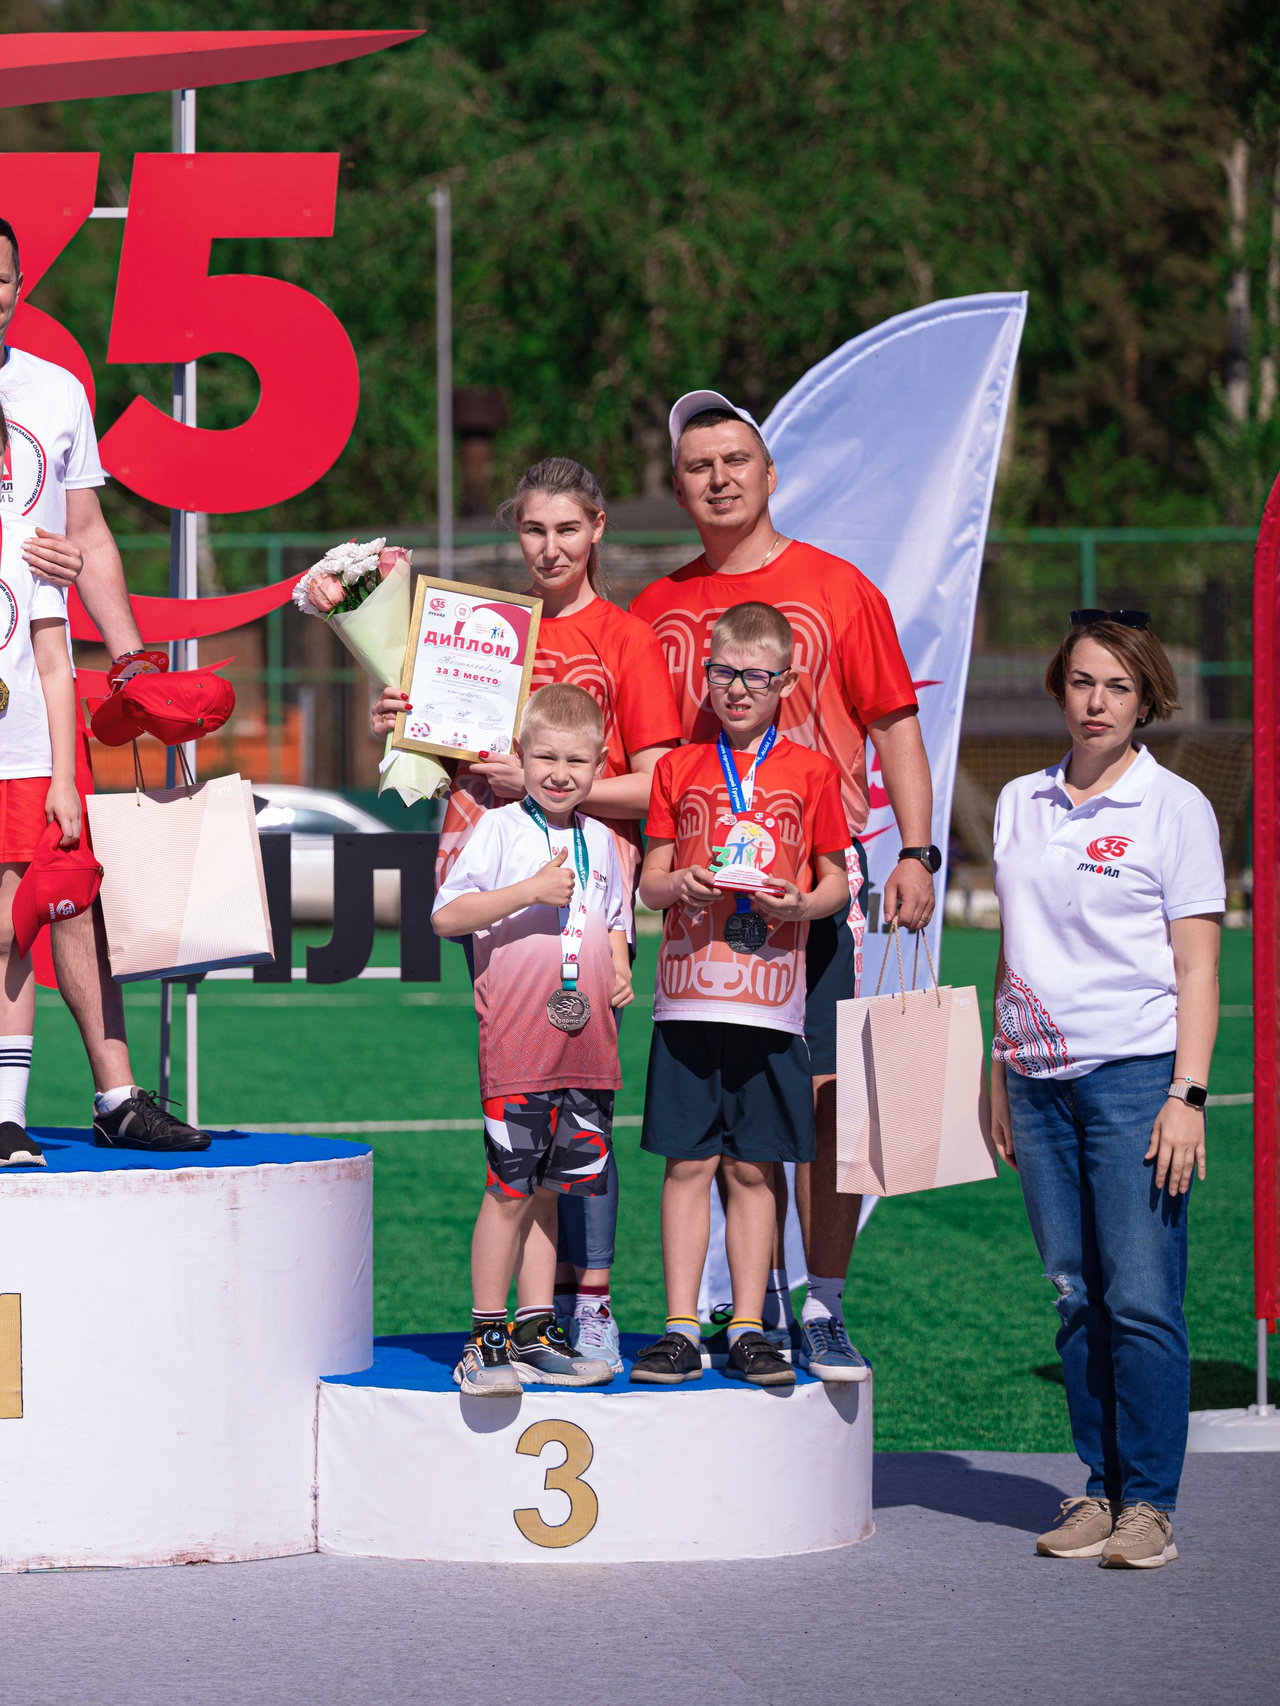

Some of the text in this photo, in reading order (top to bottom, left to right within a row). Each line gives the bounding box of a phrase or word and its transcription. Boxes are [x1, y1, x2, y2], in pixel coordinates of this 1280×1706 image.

[8, 423, 34, 444] АНИЗАЦИЯ
[32, 444, 42, 458] ООО
[436, 600, 446, 608] 35
[424, 630, 510, 658] ДИПЛОМ
[463, 672, 499, 685] место
[709, 846, 731, 872] 3
[1099, 839, 1129, 857] 35
[1077, 863, 1120, 878] ЛУКОЙЛ
[513, 1418, 599, 1549] 3
